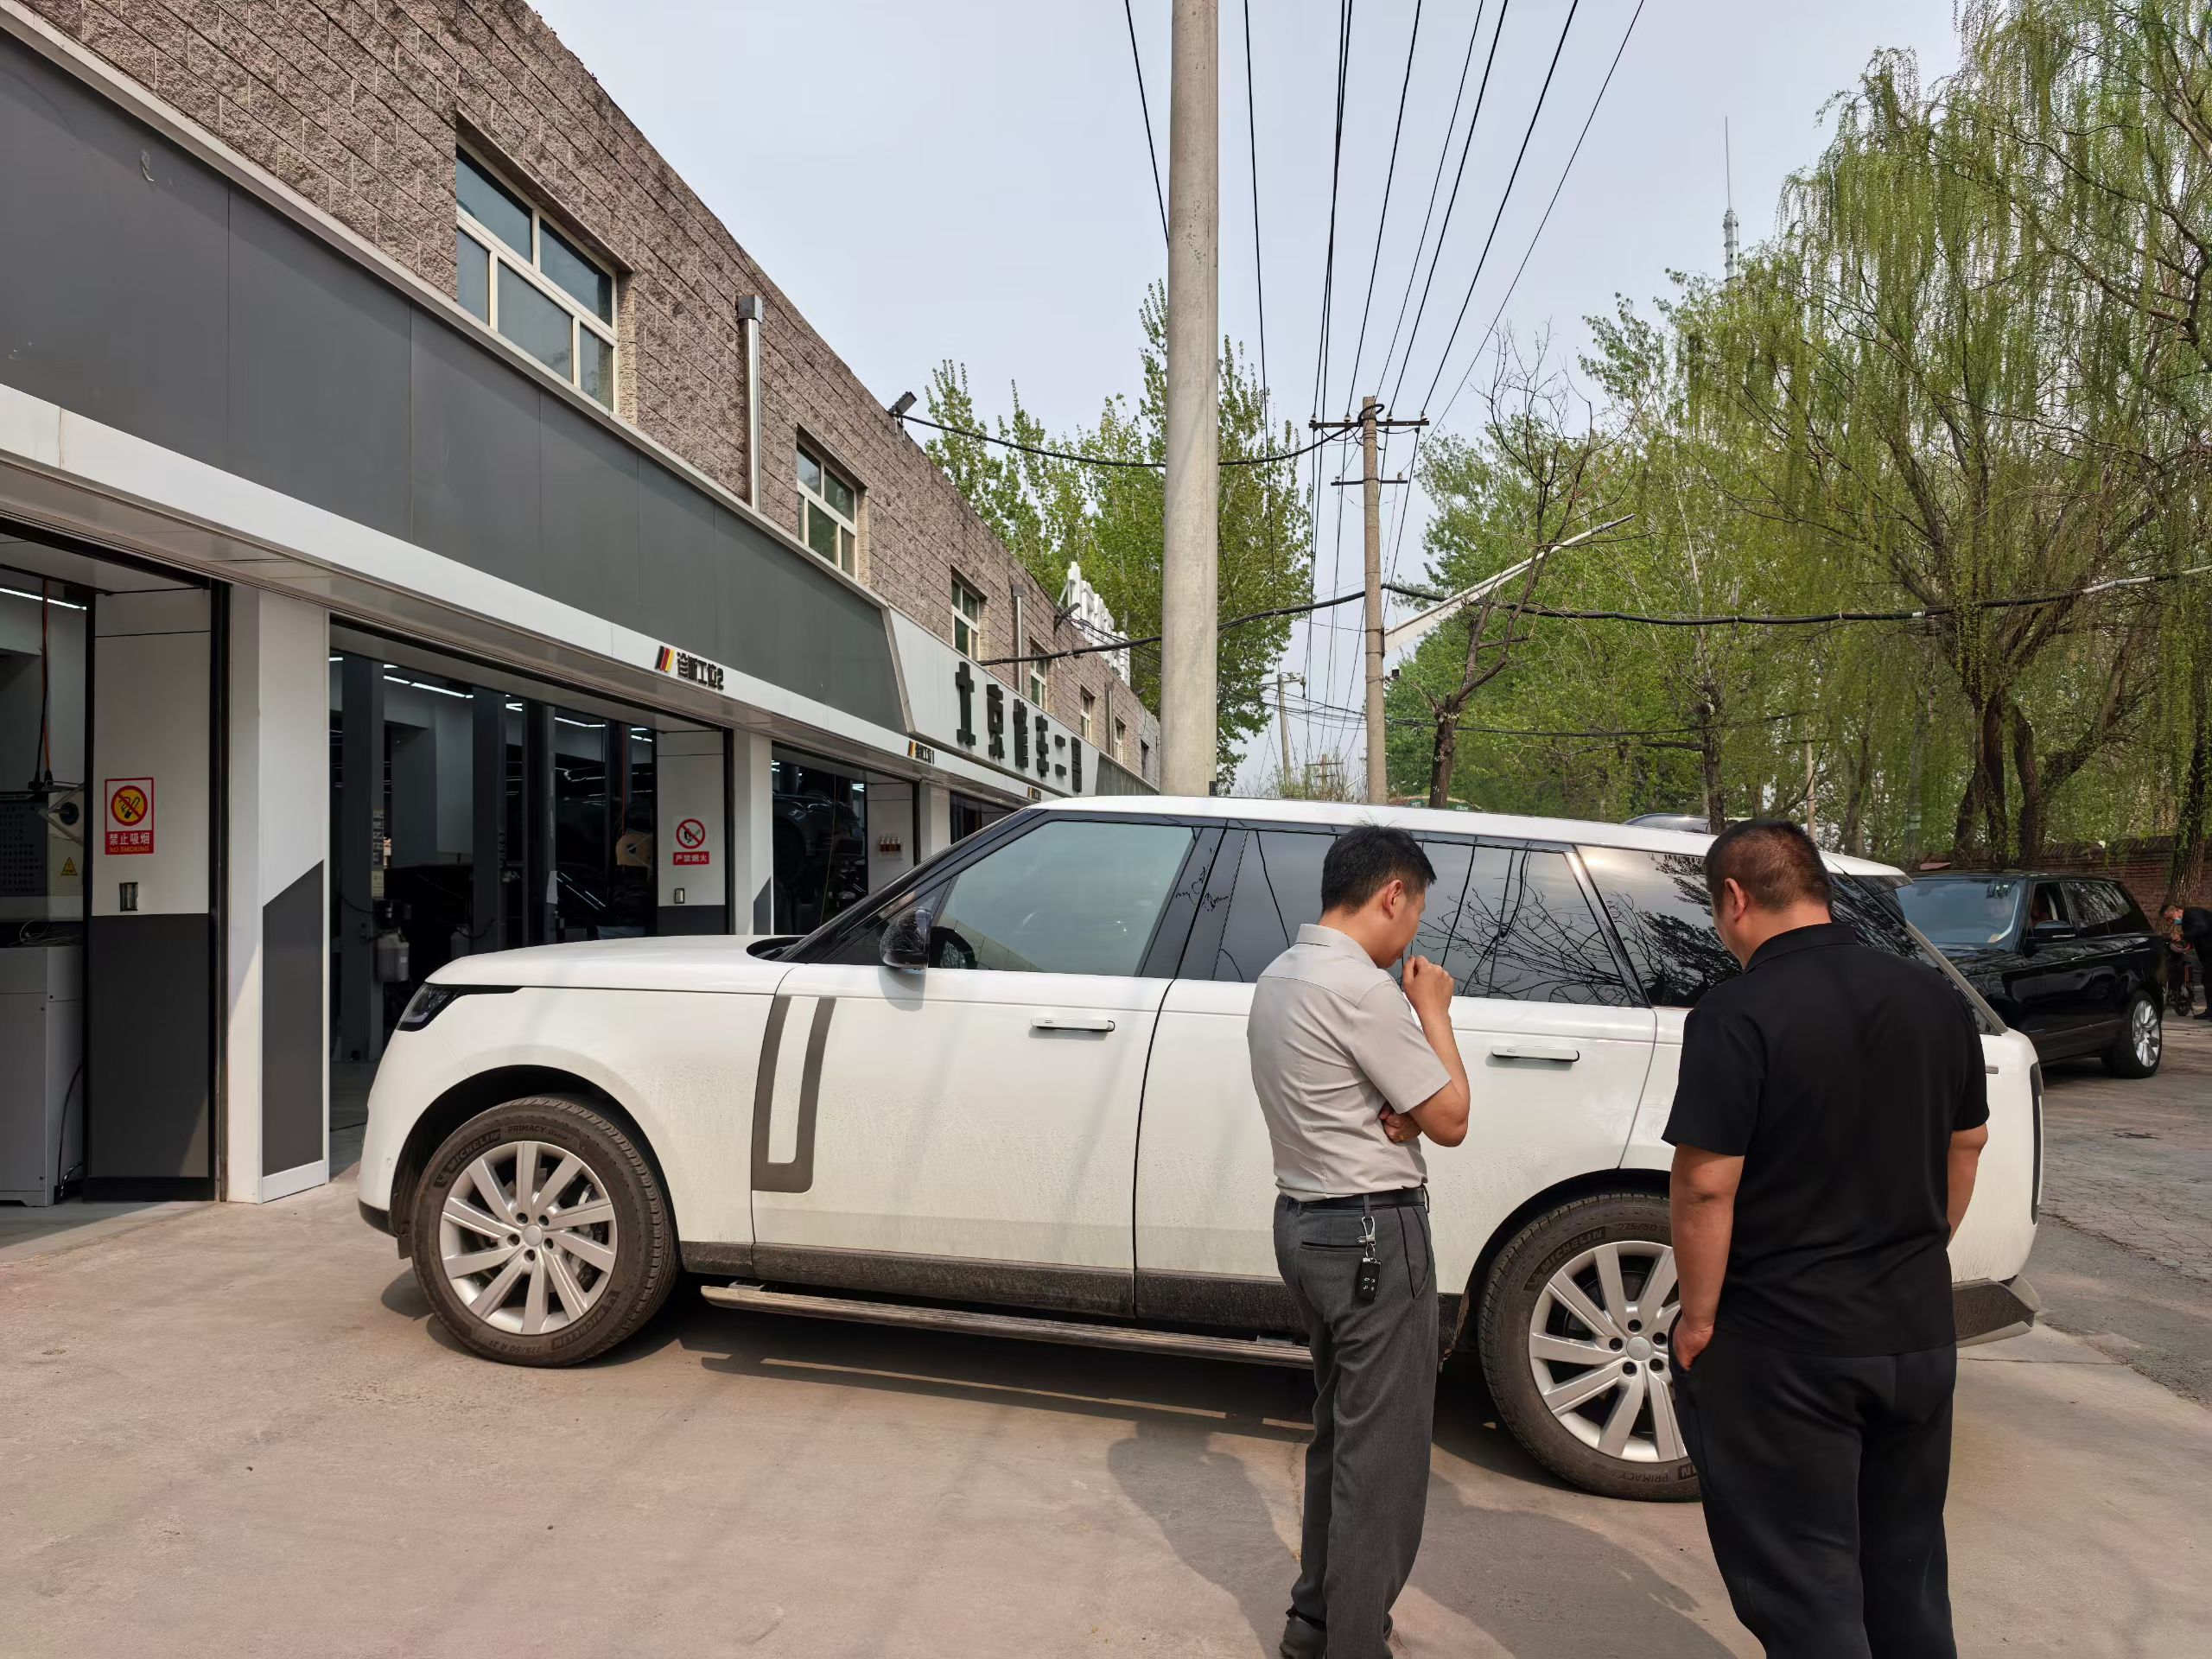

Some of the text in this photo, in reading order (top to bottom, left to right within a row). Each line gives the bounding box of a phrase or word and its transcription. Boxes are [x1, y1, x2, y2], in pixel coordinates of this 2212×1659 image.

[110, 832, 150, 845] 禁止吸烟
[449, 1131, 501, 1172] MICHELIN
[1542, 1230, 1603, 1272] MICHELIN
